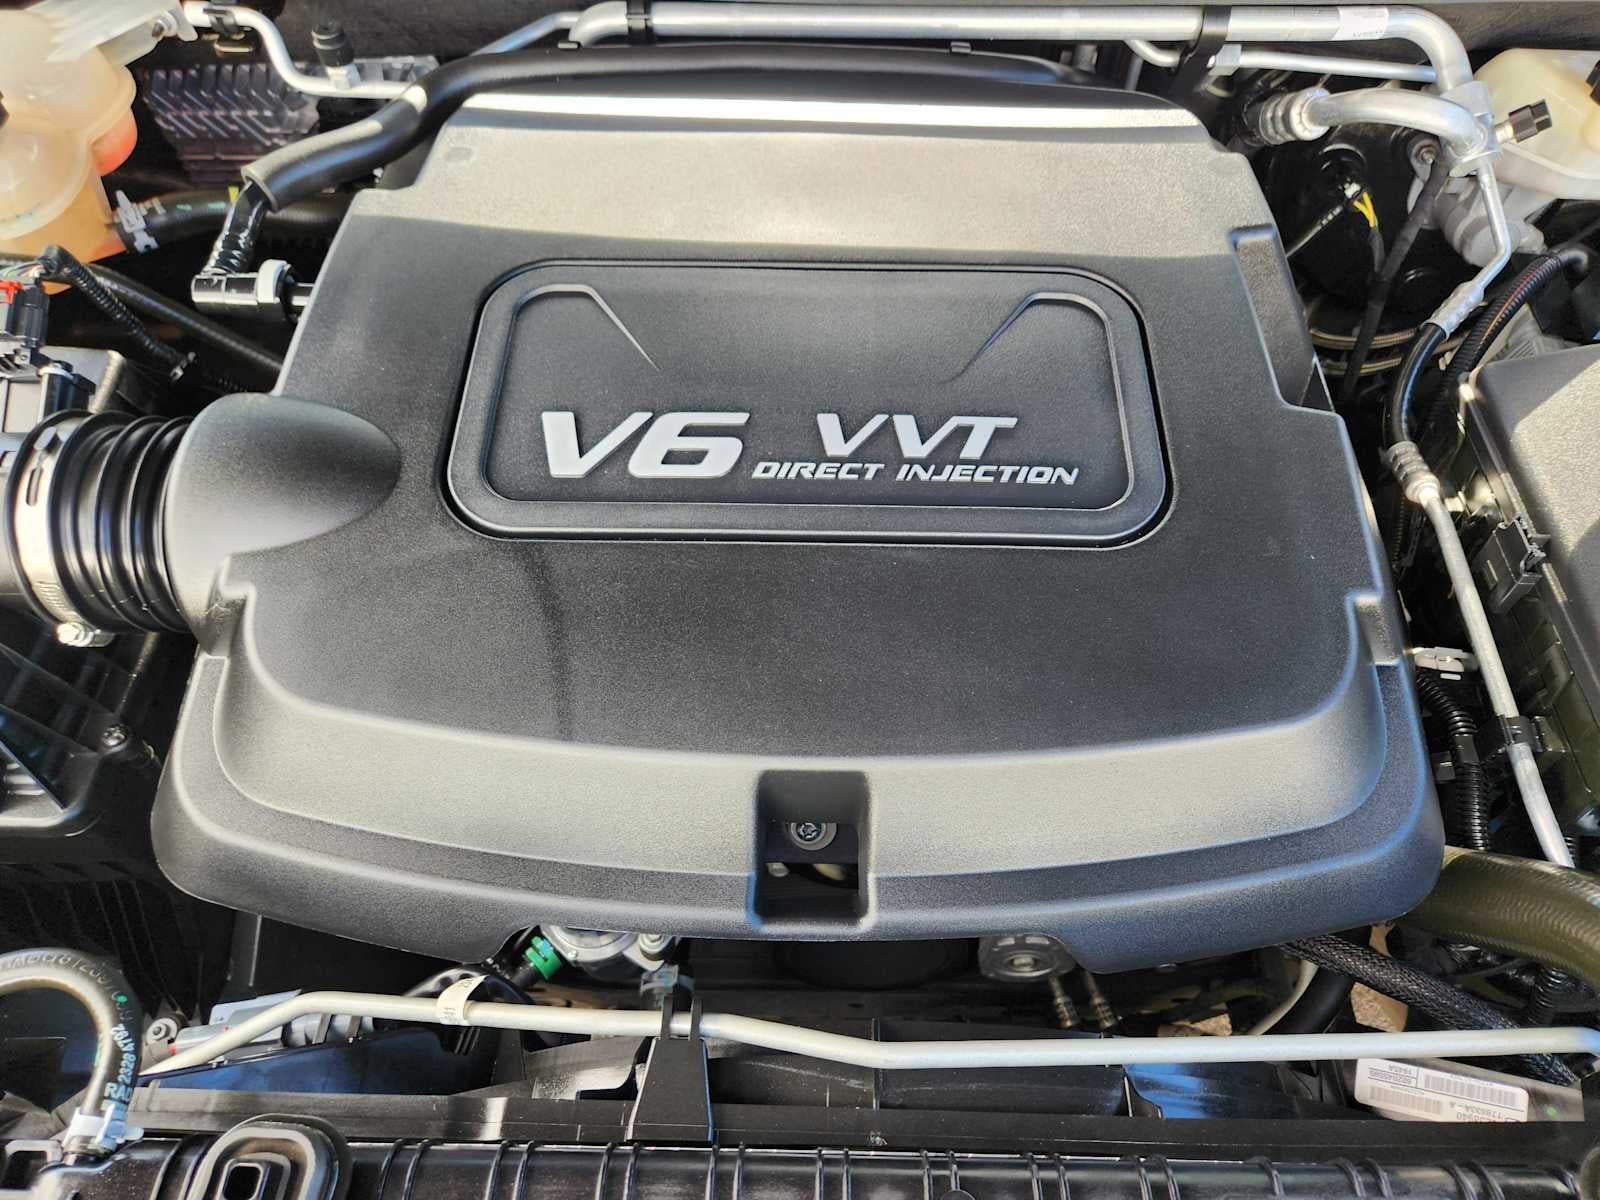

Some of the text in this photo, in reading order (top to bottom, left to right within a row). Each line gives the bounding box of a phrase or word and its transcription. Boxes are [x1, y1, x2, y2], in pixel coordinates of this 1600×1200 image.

[541, 411, 751, 478] V6
[816, 413, 1018, 460] VVT
[751, 462, 1079, 486] DIRECT INJECTION
